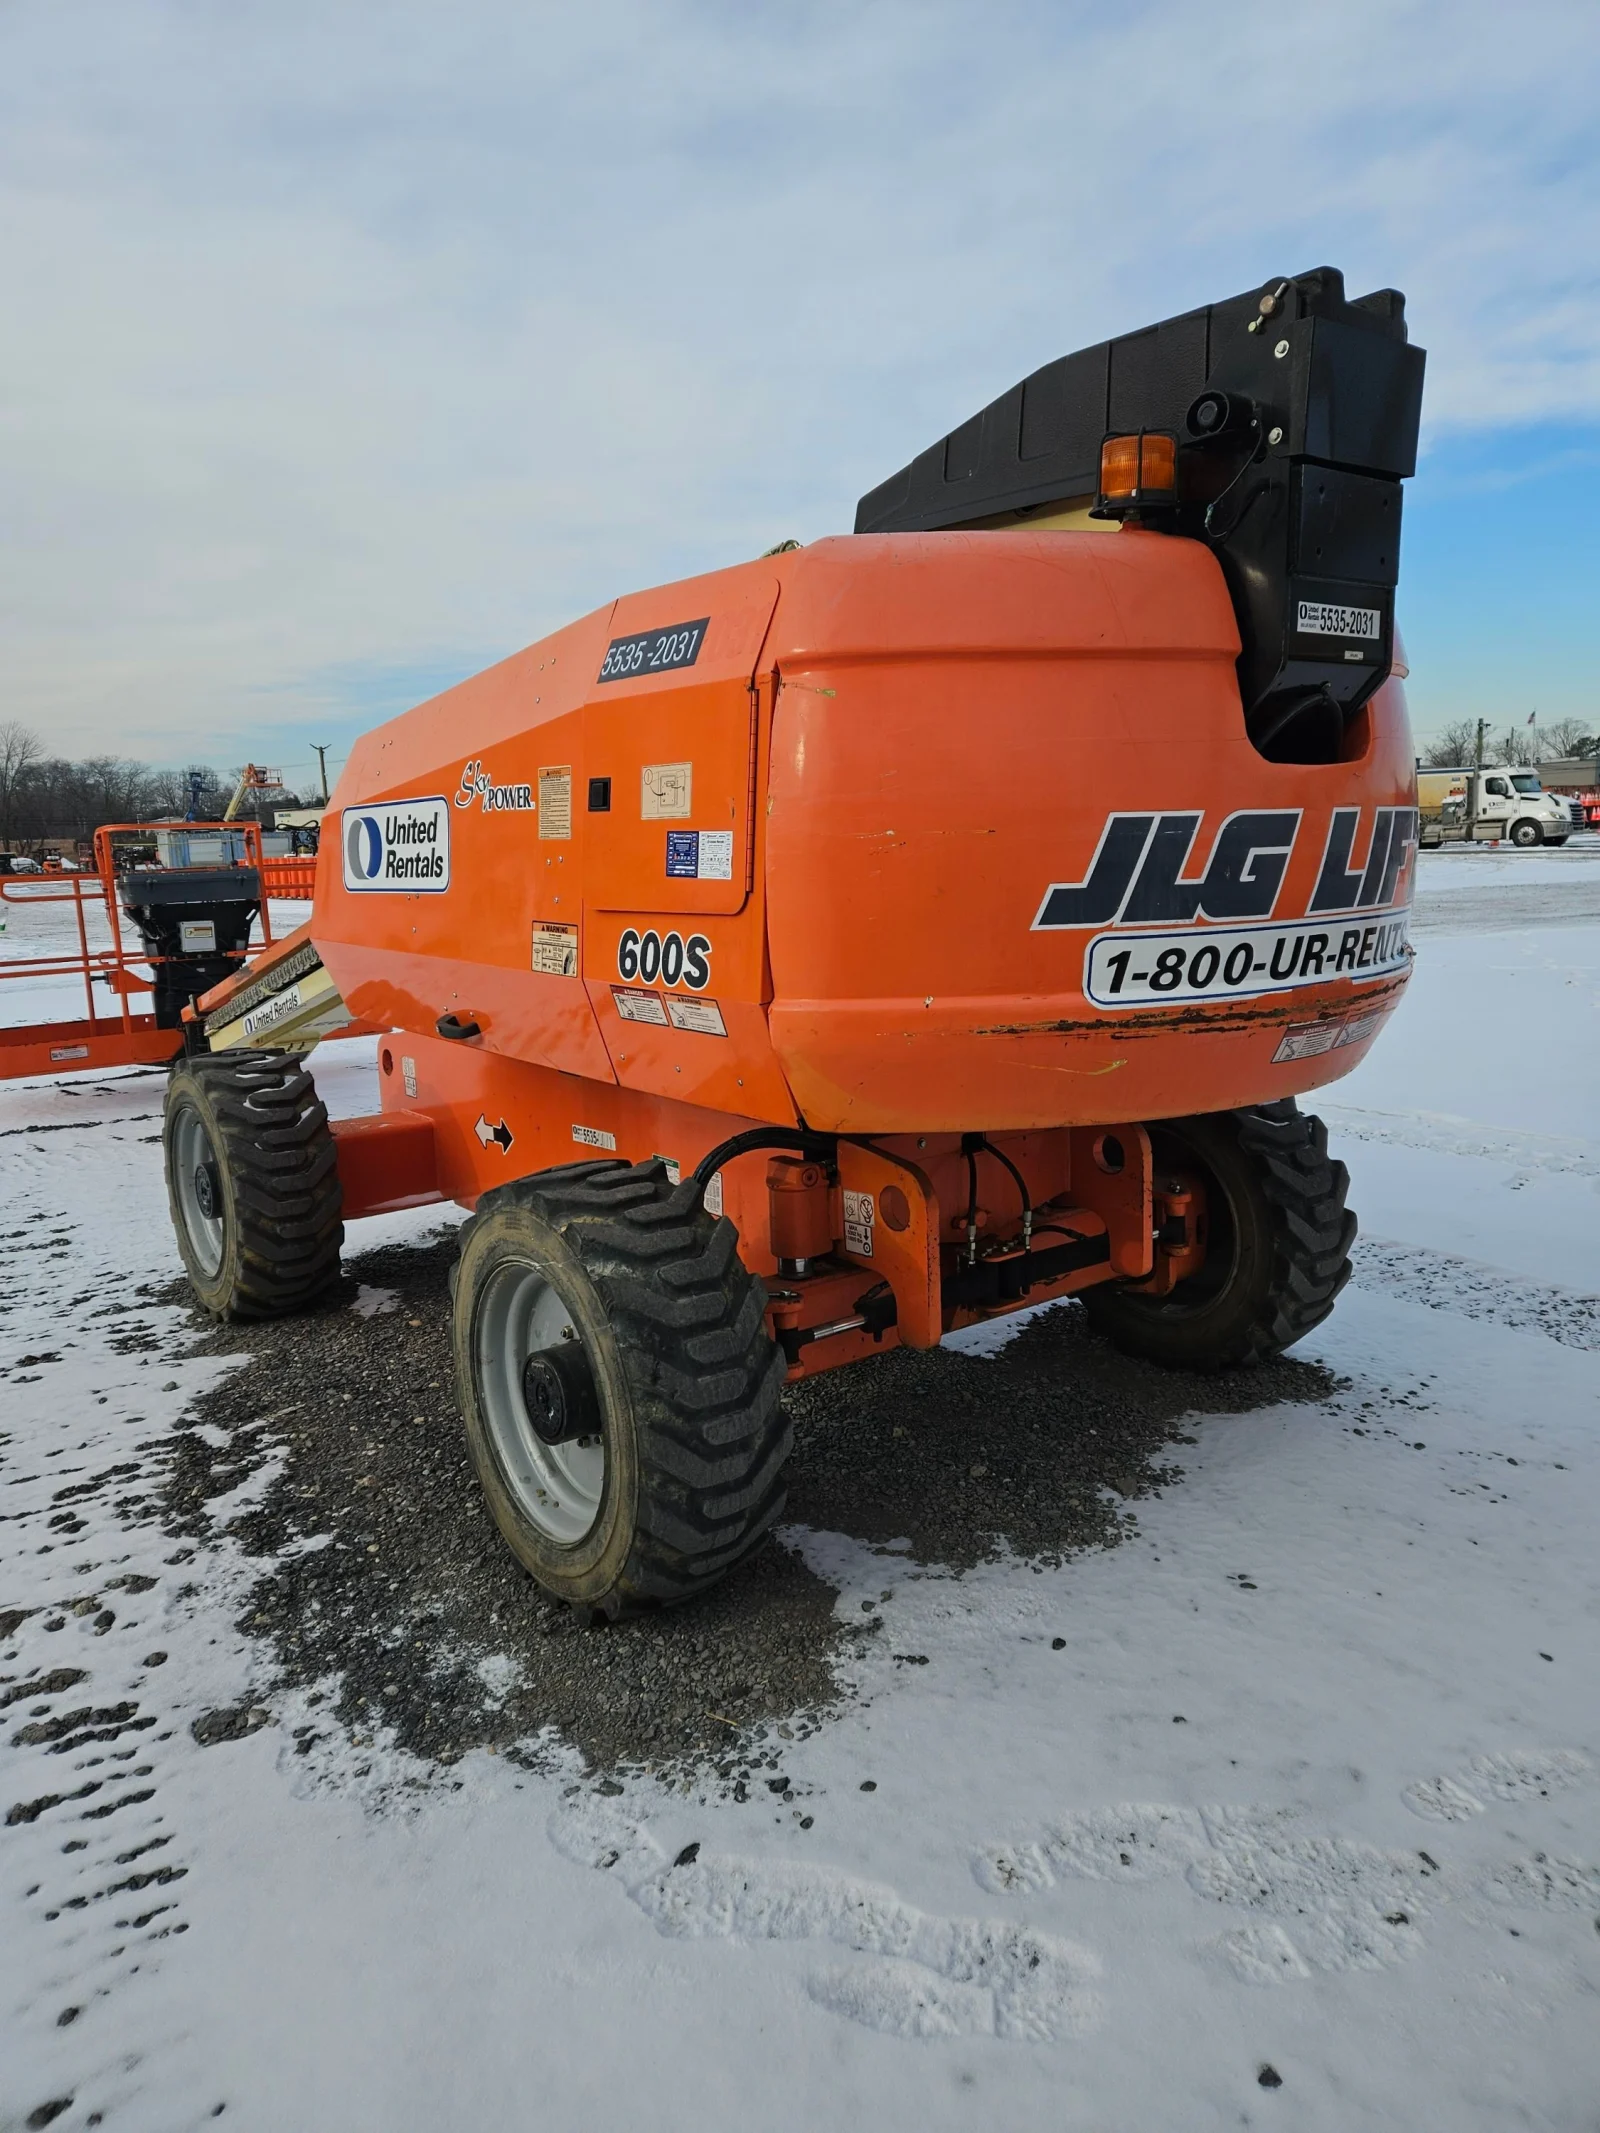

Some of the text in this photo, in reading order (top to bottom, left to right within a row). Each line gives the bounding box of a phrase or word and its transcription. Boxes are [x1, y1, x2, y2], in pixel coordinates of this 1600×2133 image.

[1320, 607, 1374, 636] 5535-2031
[601, 629, 699, 676] 5535-2031
[455, 760, 491, 812] Sky
[488, 785, 532, 810] POWER
[385, 811, 438, 846] United
[385, 847, 444, 879] Rentals
[1030, 808, 1304, 931] JLG
[545, 924, 568, 935] WARNING
[618, 929, 711, 989] 600S
[253, 992, 298, 1030] United Rentals
